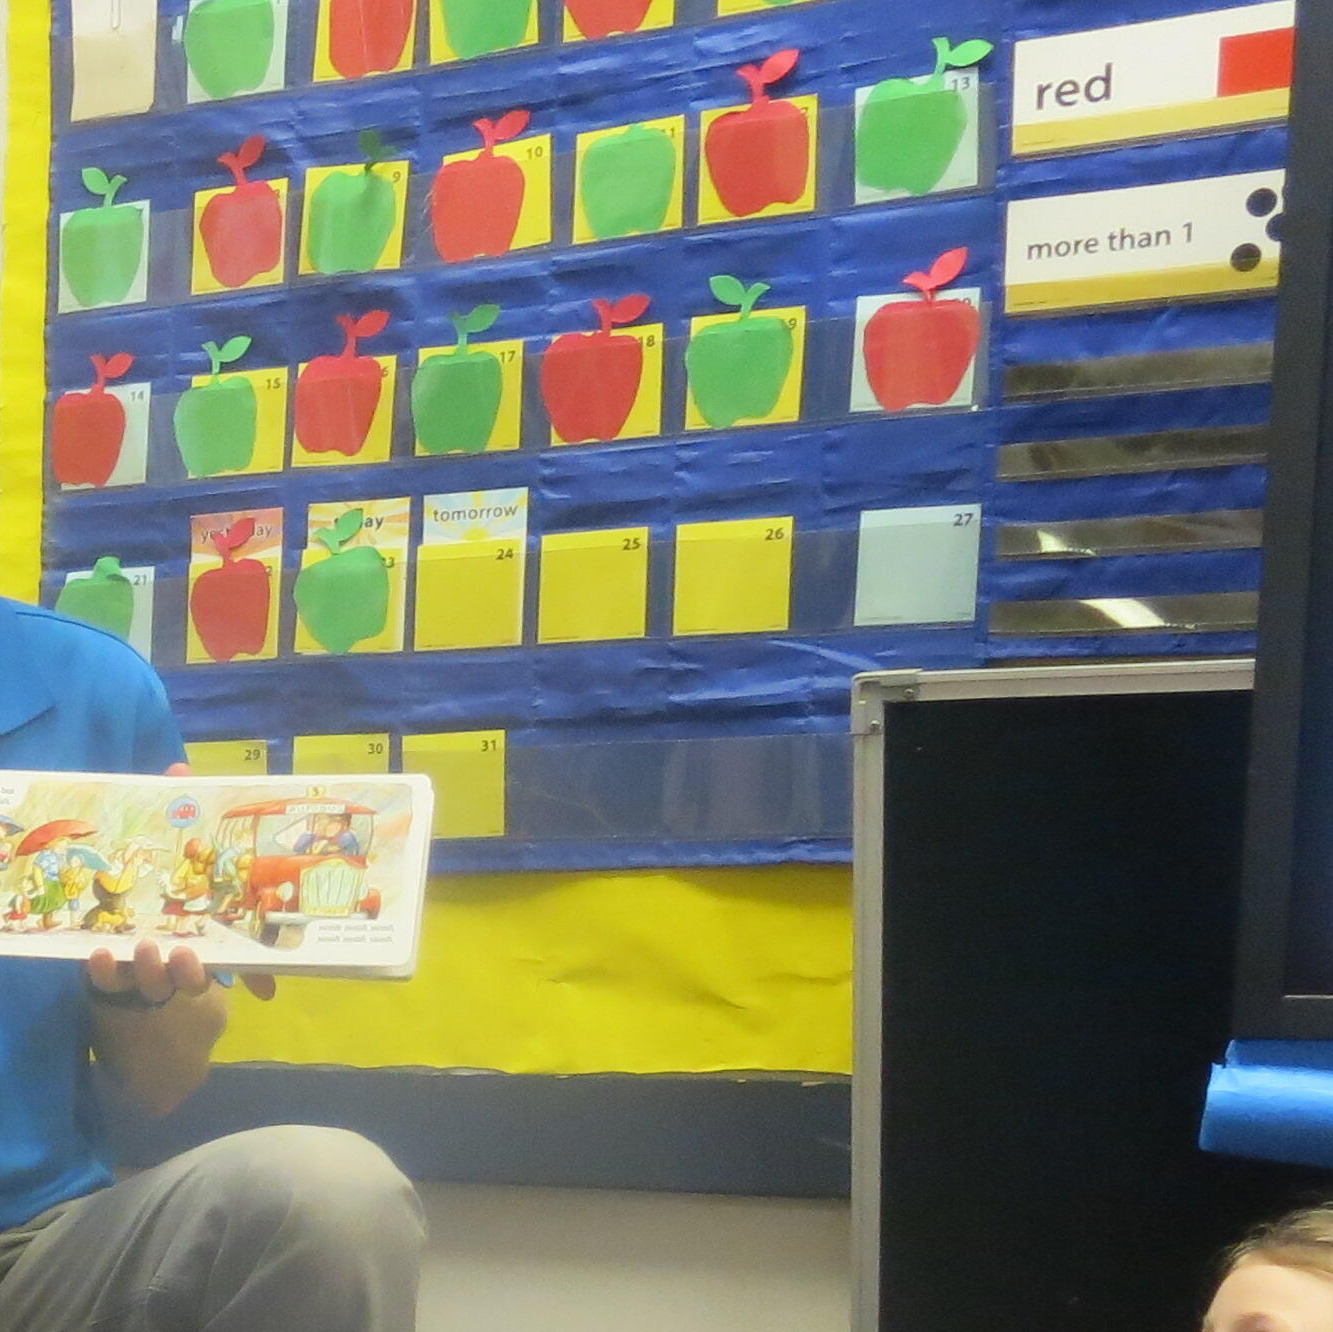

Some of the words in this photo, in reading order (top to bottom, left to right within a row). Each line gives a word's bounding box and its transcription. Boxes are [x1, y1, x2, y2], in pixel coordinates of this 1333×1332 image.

[950, 76, 971, 92] 13
[1035, 62, 1113, 111] red
[526, 145, 543, 160] 10
[392, 170, 401, 183] 9
[1026, 237, 1099, 261] more
[1108, 228, 1171, 251] than
[1182, 221, 1193, 243] 1
[499, 350, 516, 364] 17
[265, 377, 281, 390] 15
[130, 390, 144, 402] 14
[433, 504, 518, 523] tomorrow
[953, 512, 974, 527] 27
[764, 527, 784, 541] 26
[622, 537, 641, 551] 25
[496, 548, 514, 561] 24
[133, 574, 147, 586] 21
[367, 742, 384, 755] 30
[481, 739, 497, 752] 31
[244, 748, 261, 761] 29
